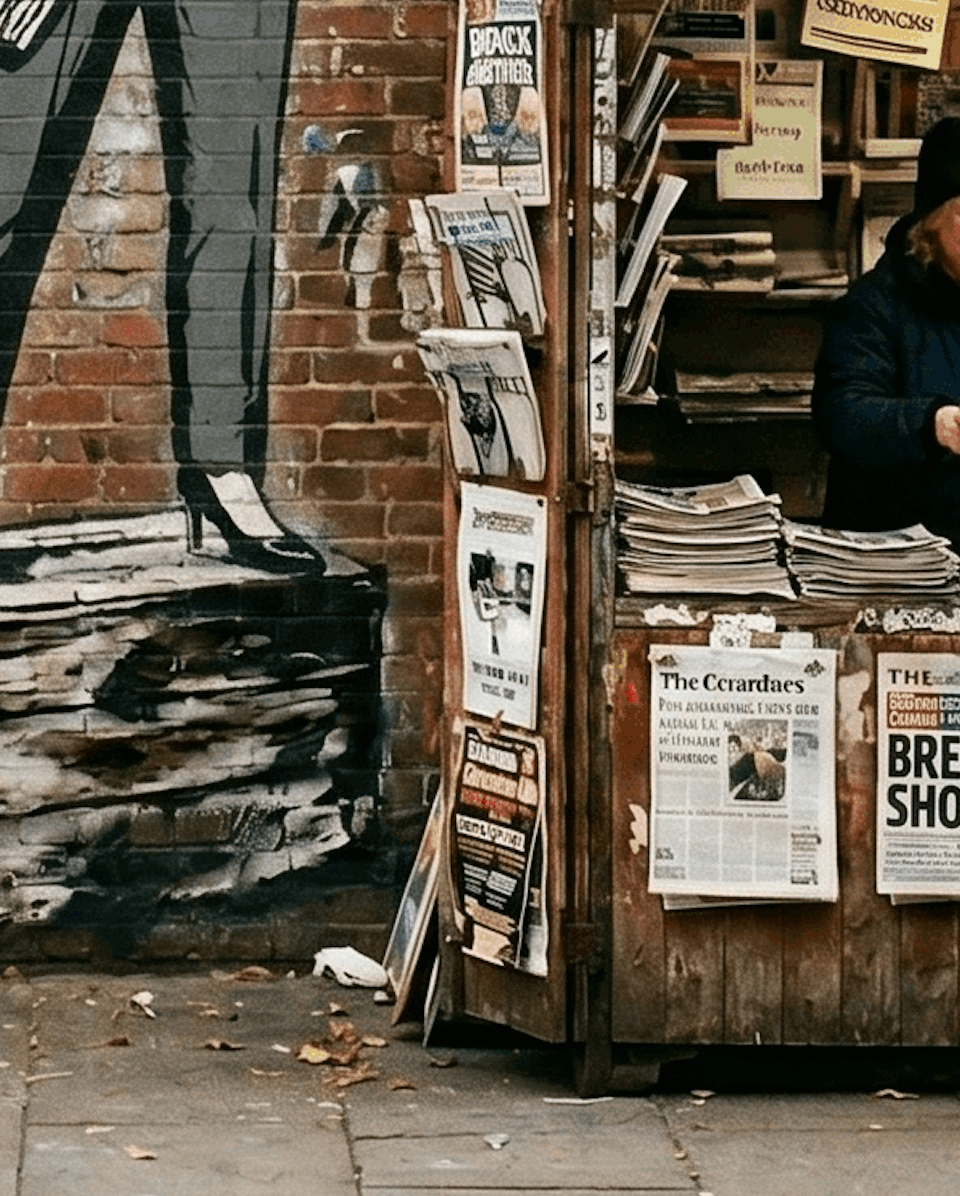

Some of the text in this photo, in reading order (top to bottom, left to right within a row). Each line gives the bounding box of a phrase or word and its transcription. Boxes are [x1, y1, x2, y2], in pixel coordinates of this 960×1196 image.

[659, 672, 699, 691] The
[887, 668, 933, 686] THE
[888, 734, 960, 779] BRE
[886, 783, 960, 829] SHO
